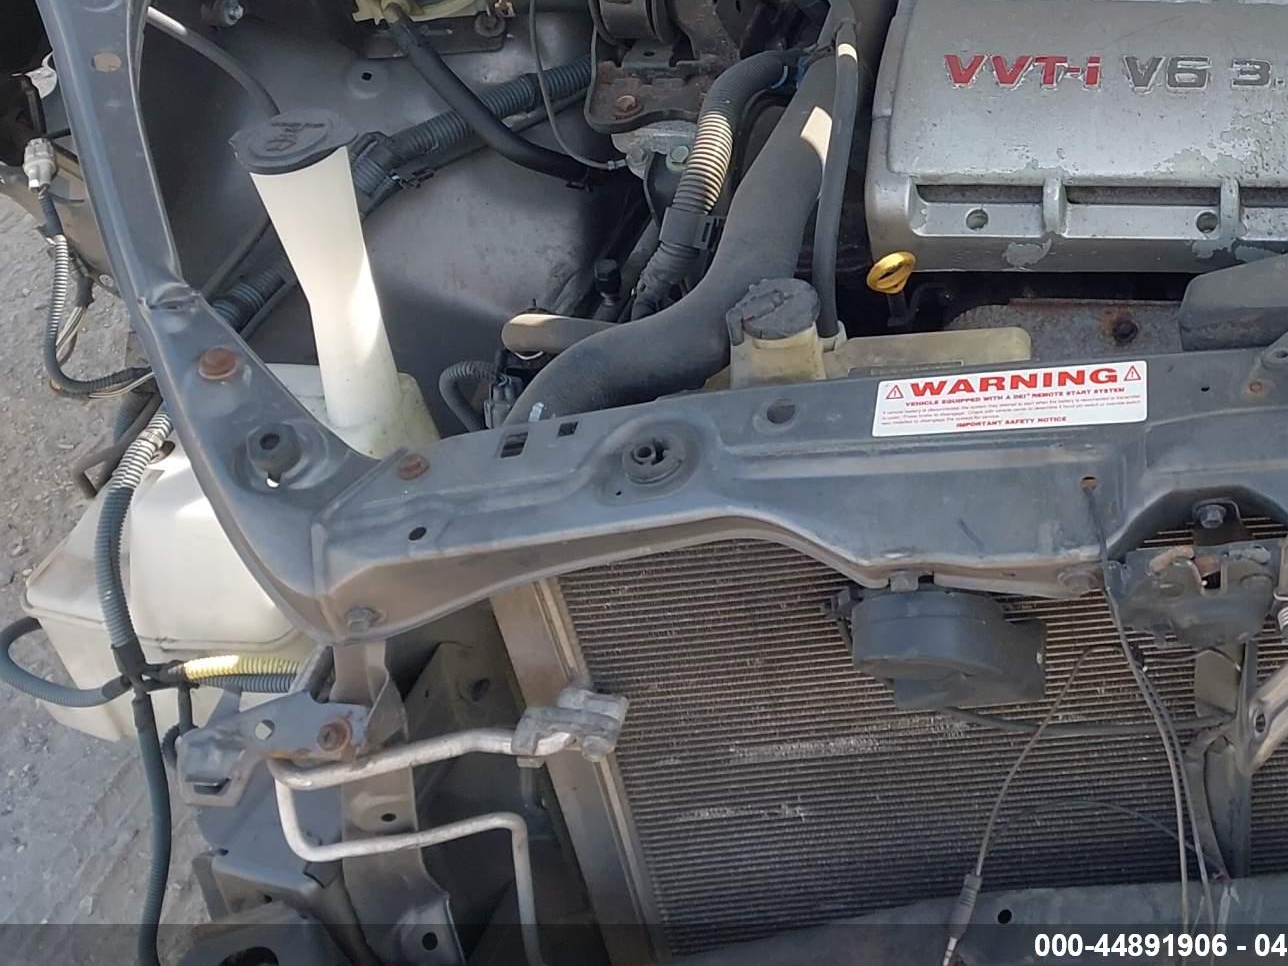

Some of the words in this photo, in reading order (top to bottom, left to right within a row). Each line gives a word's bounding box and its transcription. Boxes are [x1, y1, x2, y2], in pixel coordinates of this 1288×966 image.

[944, 54, 1101, 89] VVT-i
[1123, 55, 1213, 91] V6
[910, 368, 1118, 397] WARNING
[956, 420, 1004, 428] IMPORTANT
